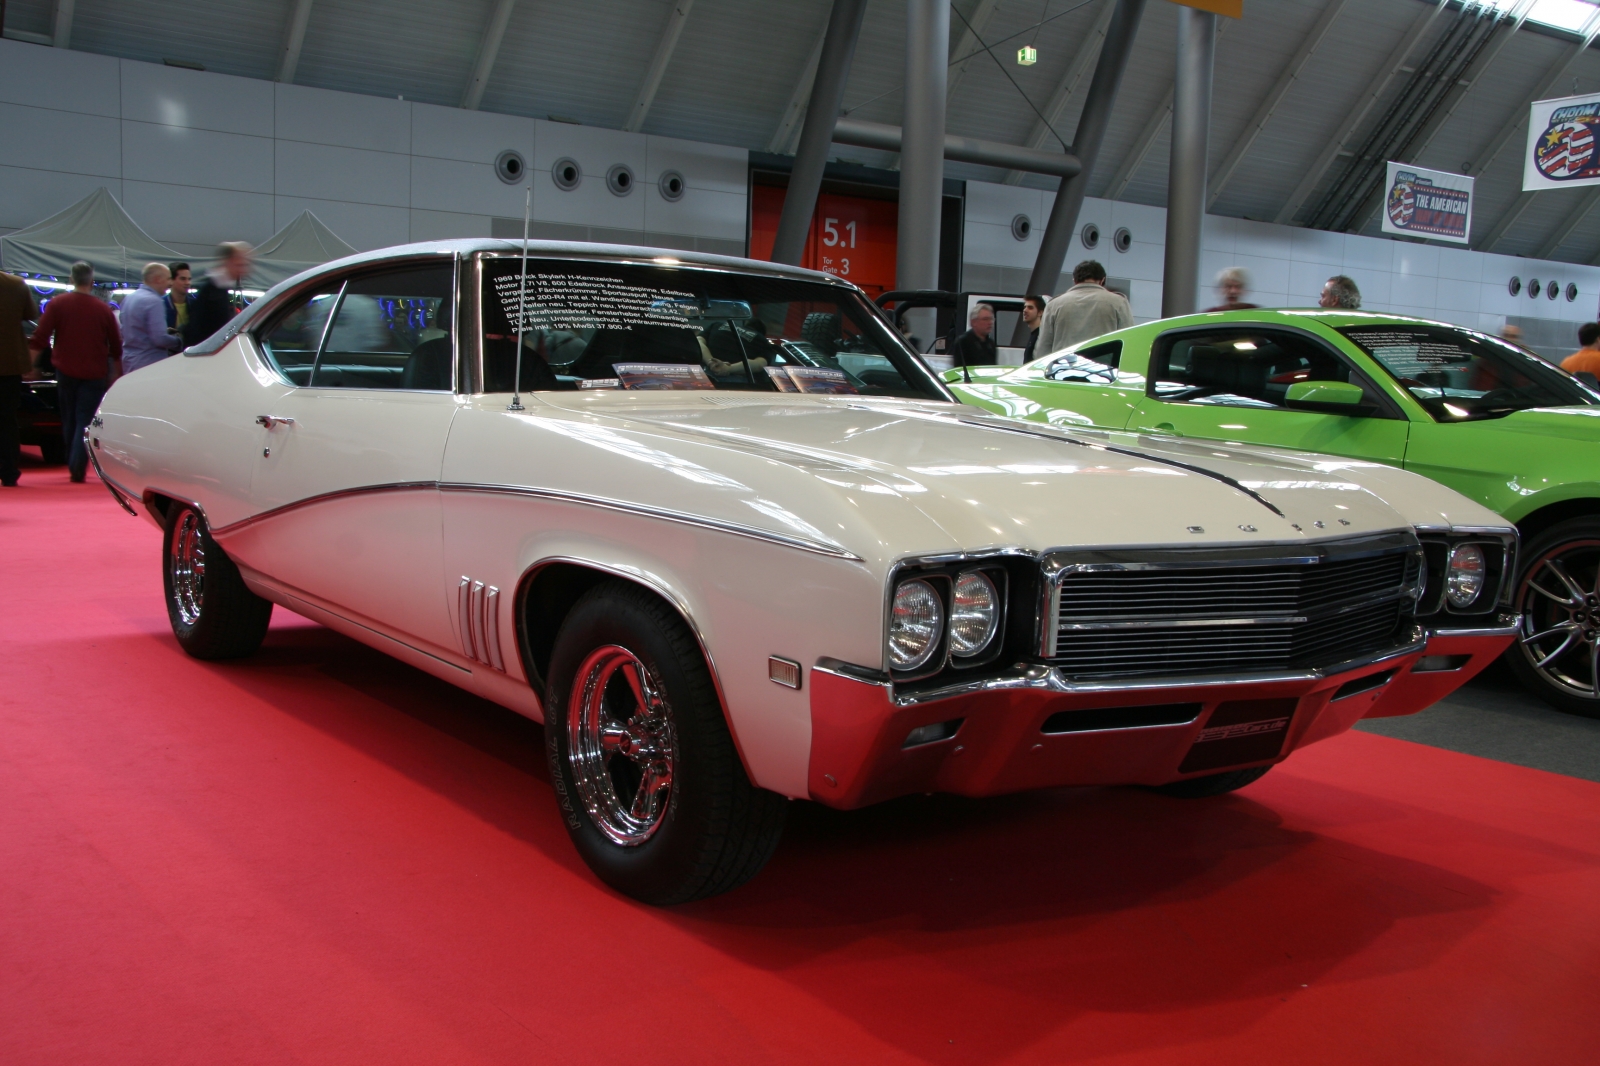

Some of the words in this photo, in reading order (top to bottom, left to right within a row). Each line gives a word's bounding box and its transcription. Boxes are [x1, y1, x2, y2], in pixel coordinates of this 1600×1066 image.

[1416, 194, 1430, 209] THE
[1429, 196, 1468, 215] AMERICAN
[823, 217, 856, 249] 5.1
[822, 256, 833, 265] Tor
[822, 265, 838, 274] Gate
[840, 257, 850, 275] 3
[493, 275, 513, 283] 1969
[537, 273, 567, 281] Skylark
[495, 282, 518, 290] Motor
[567, 281, 606, 289] Edelbrock
[500, 295, 535, 305] Getribe
[503, 304, 519, 312] und
[566, 301, 598, 309] Teppich
[511, 326, 533, 334] Peis
[549, 736, 582, 830] RADIAL
